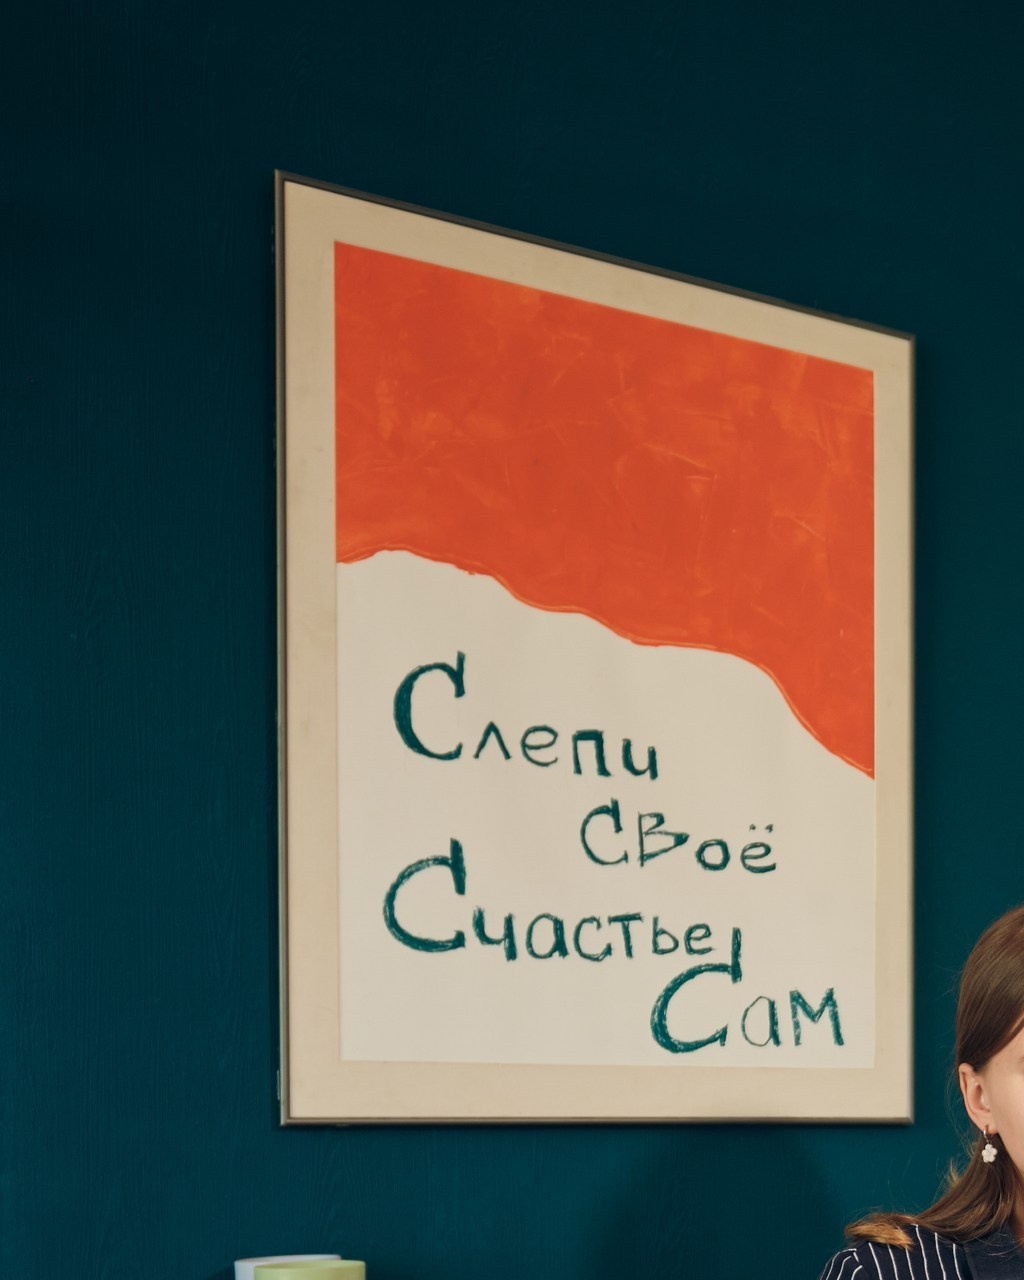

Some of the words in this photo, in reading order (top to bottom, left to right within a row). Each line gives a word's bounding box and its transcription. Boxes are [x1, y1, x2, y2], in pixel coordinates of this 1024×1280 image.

[394, 651, 659, 780] Слепи
[383, 838, 714, 962] Счастье
[651, 928, 845, 1053] Сам
